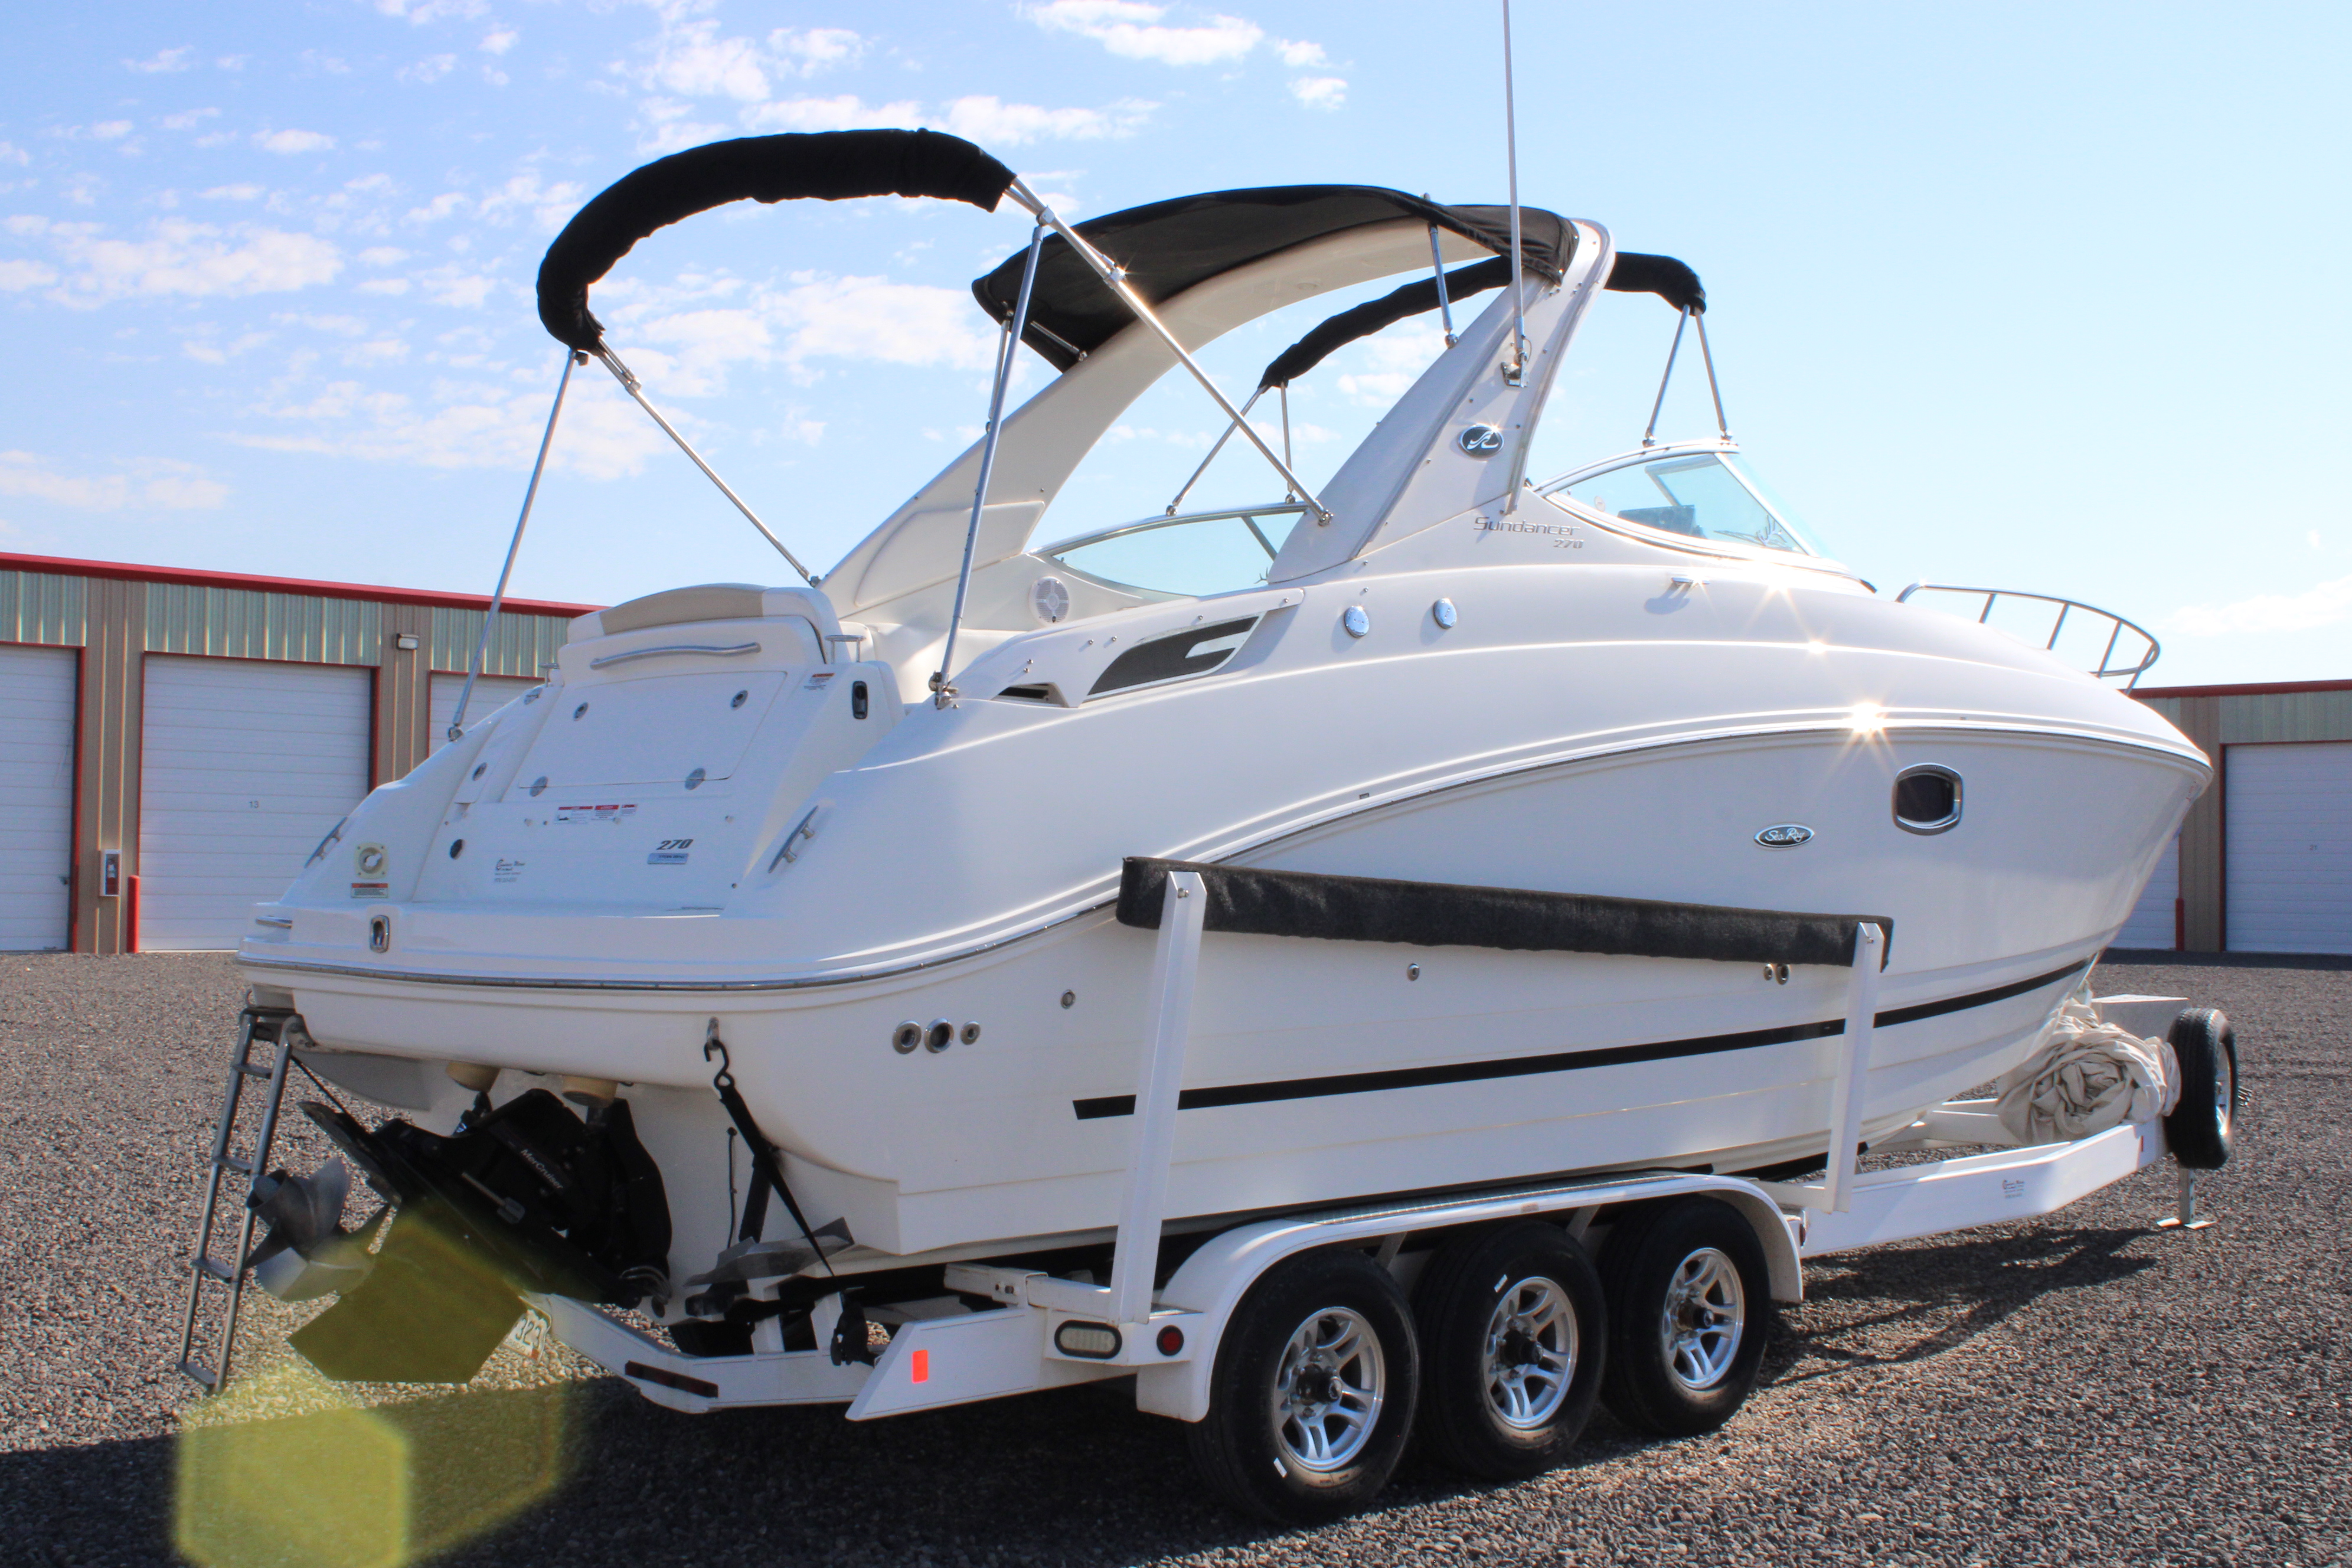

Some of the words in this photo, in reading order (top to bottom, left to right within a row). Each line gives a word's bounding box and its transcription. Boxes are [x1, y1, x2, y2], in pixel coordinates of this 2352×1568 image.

[1474, 517, 1580, 535] Sundancer
[1553, 538, 1585, 549] 270
[1765, 829, 1784, 841] Sea
[1785, 827, 1805, 842] Ray
[656, 839, 693, 850] 270
[521, 1148, 564, 1188] MerCruiser
